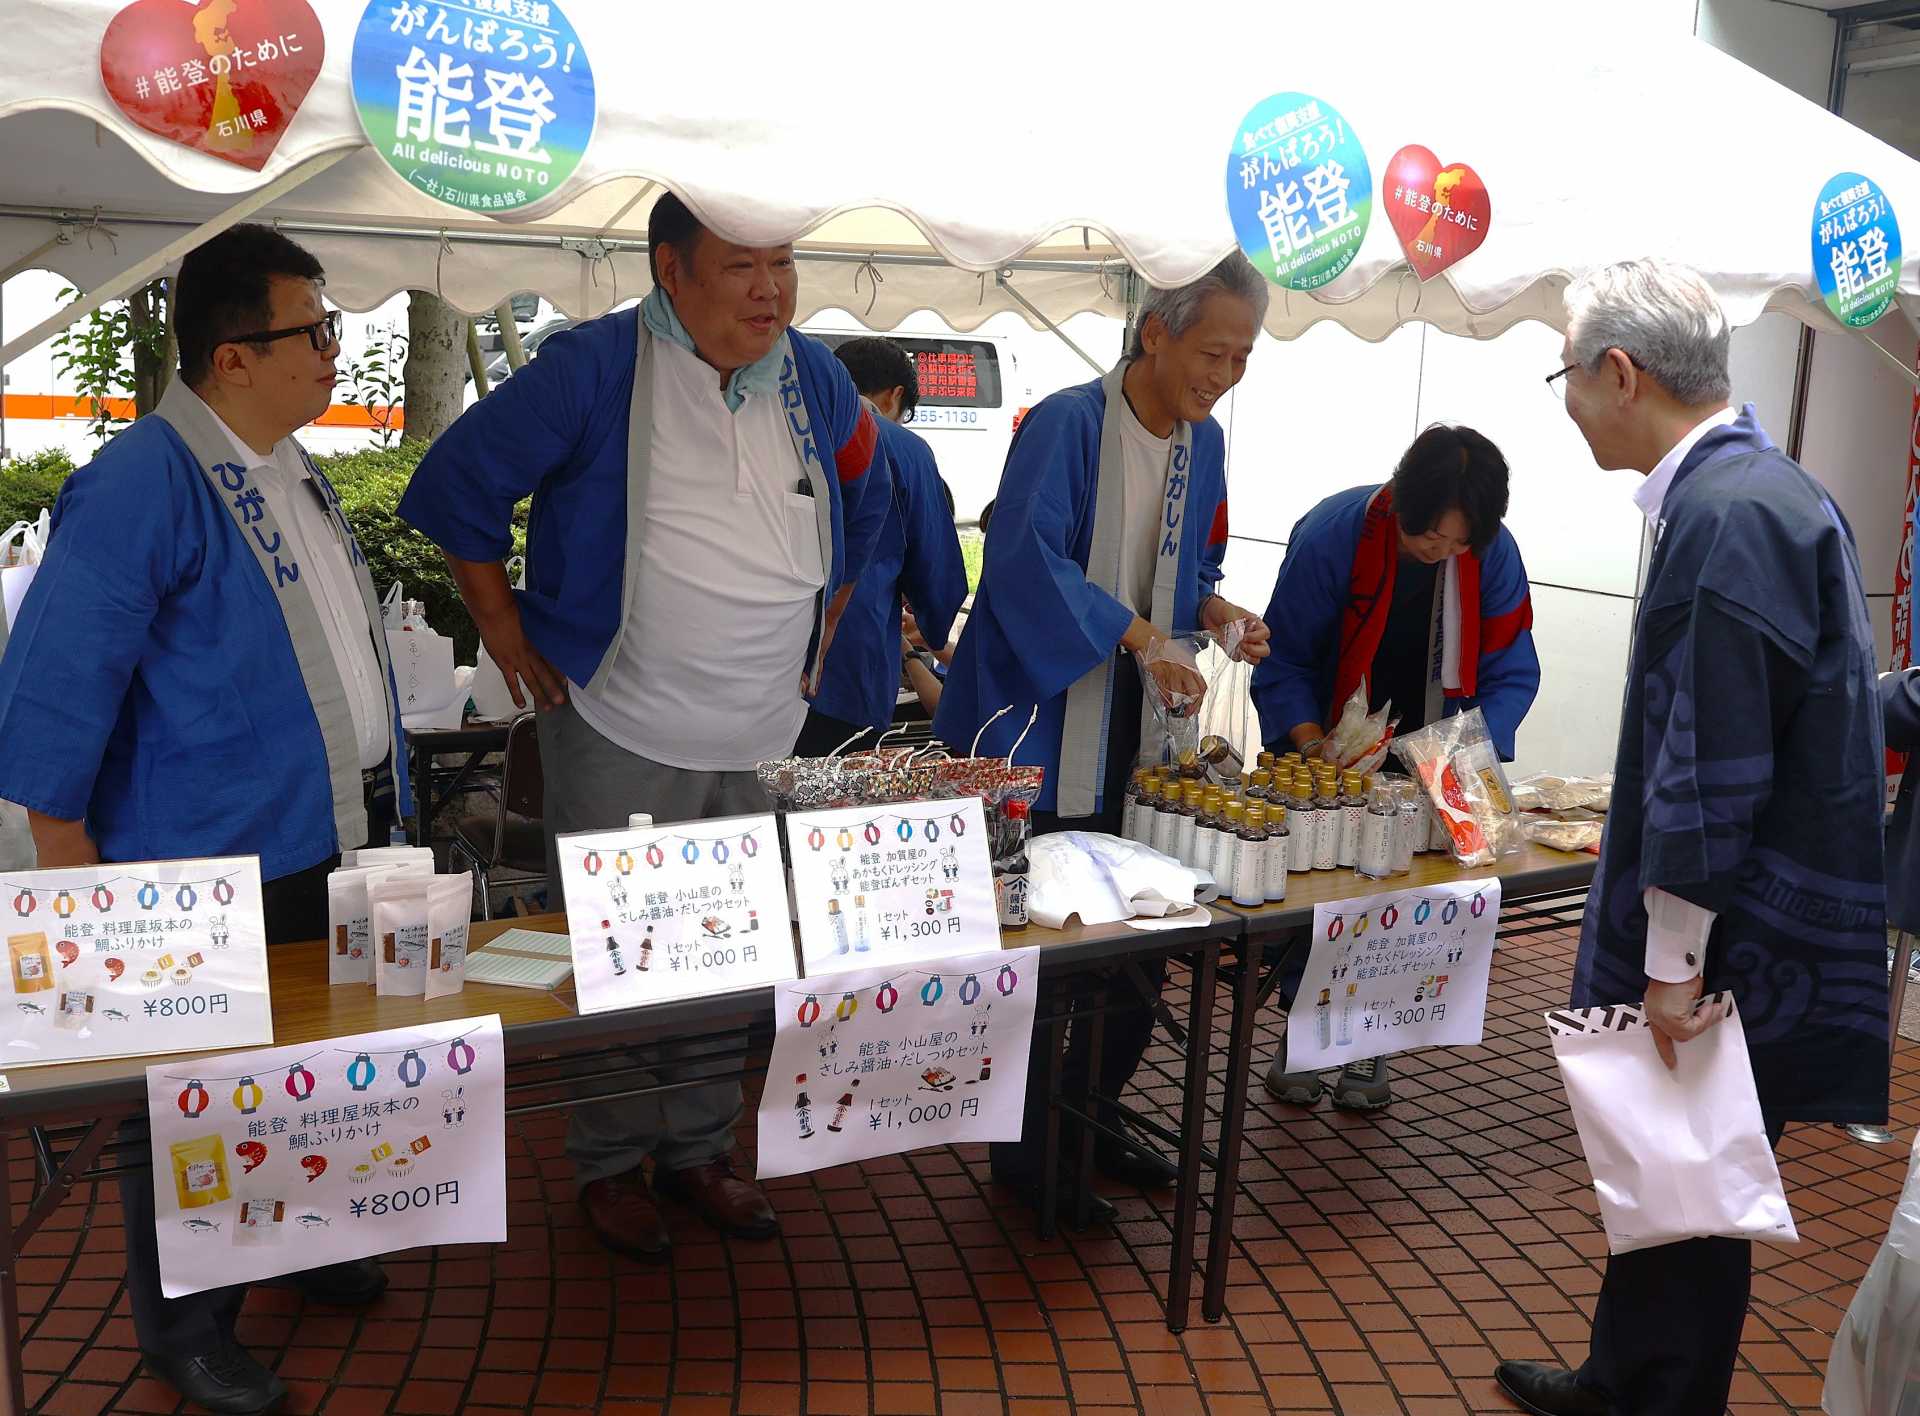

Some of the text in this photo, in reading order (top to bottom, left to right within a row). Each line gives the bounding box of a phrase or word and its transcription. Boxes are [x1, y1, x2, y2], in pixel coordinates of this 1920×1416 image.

[390, 1, 575, 73] がんばろう!
[395, 46, 557, 164] 能登
[215, 108, 268, 138] 石川県
[393, 142, 550, 186] All delicious NOTO
[1240, 117, 1345, 189] がんばろう!
[1257, 159, 1358, 263] 能登
[1819, 194, 1887, 245] がんばろう!
[1275, 226, 1362, 278] All delicious NOTO
[1415, 239, 1442, 258] 石川県
[1830, 226, 1893, 303] 能登
[1160, 444, 1189, 557] ひがしん
[211, 461, 299, 588] ひがしん
[852, 860, 938, 879] あかもくドレッシング
[860, 848, 927, 866] 能登 加賀屋の
[644, 886, 722, 907] 能登 小山屋の
[64, 918, 193, 938] 能登 料理屋坂本の
[94, 936, 165, 952] 鯛ふりかけ
[1366, 931, 1438, 952] 能登 加賀屋の
[1353, 943, 1445, 967] あかもくドレッシング
[143, 993, 229, 1017] ¥800円
[858, 1031, 959, 1057] 能登 小山屋の
[247, 1096, 420, 1138] 能登 料理屋坂本の
[288, 1121, 383, 1152] 鯛ふりかけ
[349, 1180, 460, 1219] ¥800円
